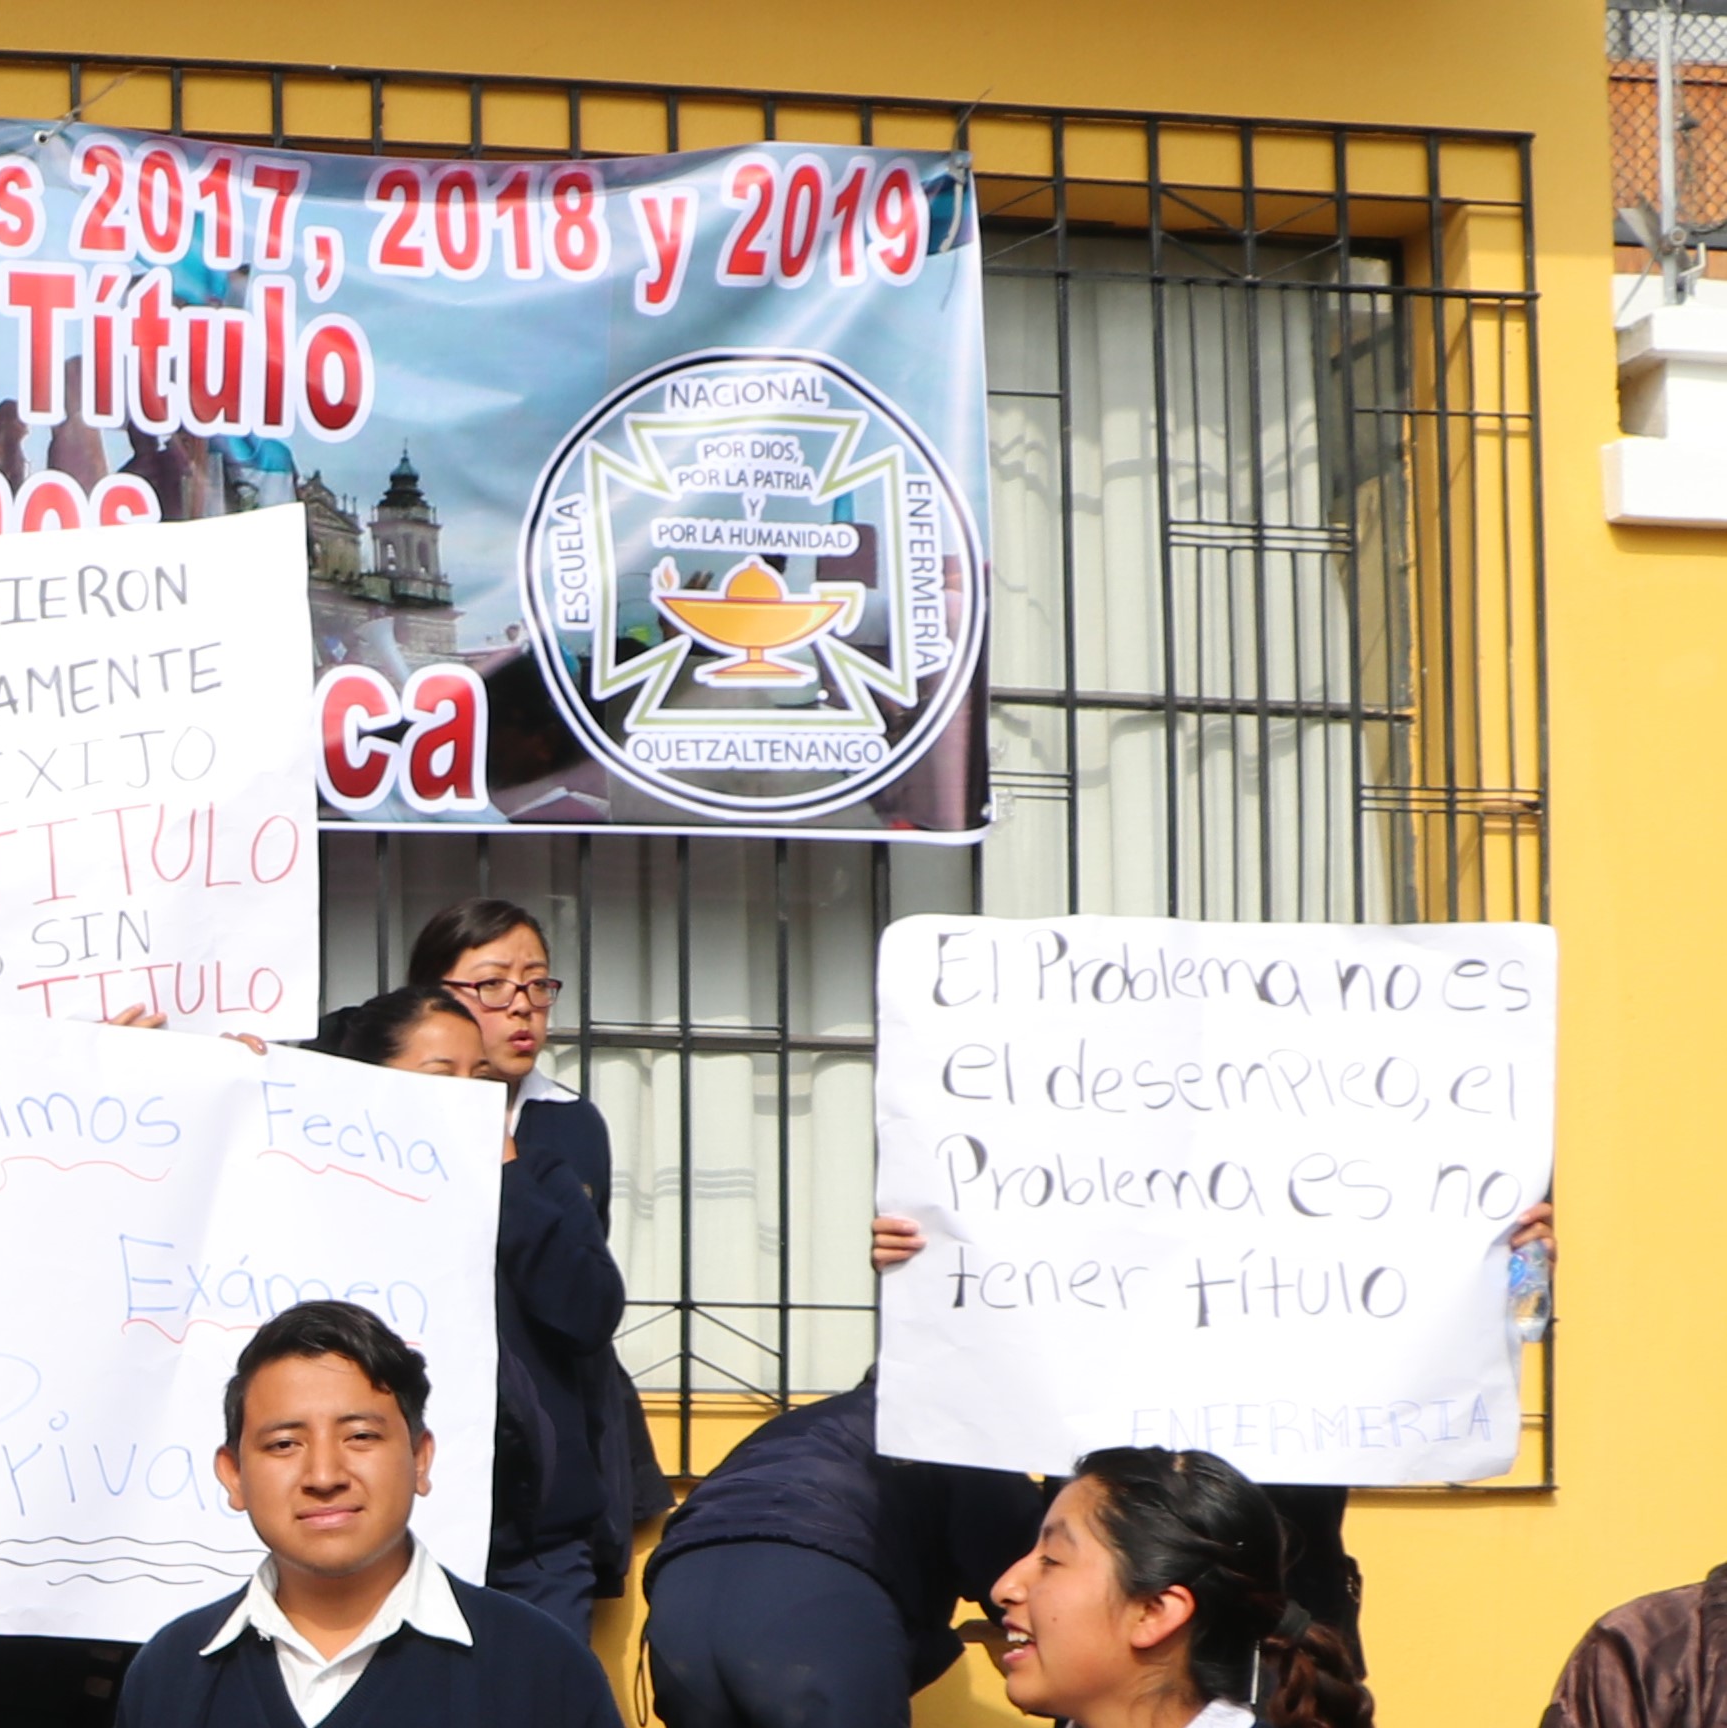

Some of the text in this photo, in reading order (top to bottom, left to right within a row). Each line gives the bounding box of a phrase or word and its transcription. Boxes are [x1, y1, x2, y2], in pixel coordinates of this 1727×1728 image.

[80, 144, 335, 296] 2017,
[375, 167, 601, 274] 2018
[637, 195, 688, 305] y
[723, 164, 921, 277] 2019
[9, 270, 363, 432] Título
[670, 377, 825, 408] NACIONAL
[678, 469, 813, 490] POR LA PATRIA
[703, 441, 745, 459] POR
[658, 524, 852, 548] POR LA HUMANIDAD
[747, 499, 760, 516] Y
[556, 498, 590, 624] ESCUELA
[633, 738, 884, 764] QUETZALTENANGO
[31, 910, 152, 969] SIN
[932, 930, 1531, 1015] El Problema no es
[16, 962, 284, 1021] TITULO
[942, 1042, 1015, 1104] el
[1450, 1062, 1517, 1120] el
[260, 1081, 449, 1180] Fecha
[937, 1133, 1522, 1220] Problema es no
[947, 1246, 1407, 1329] tener título
